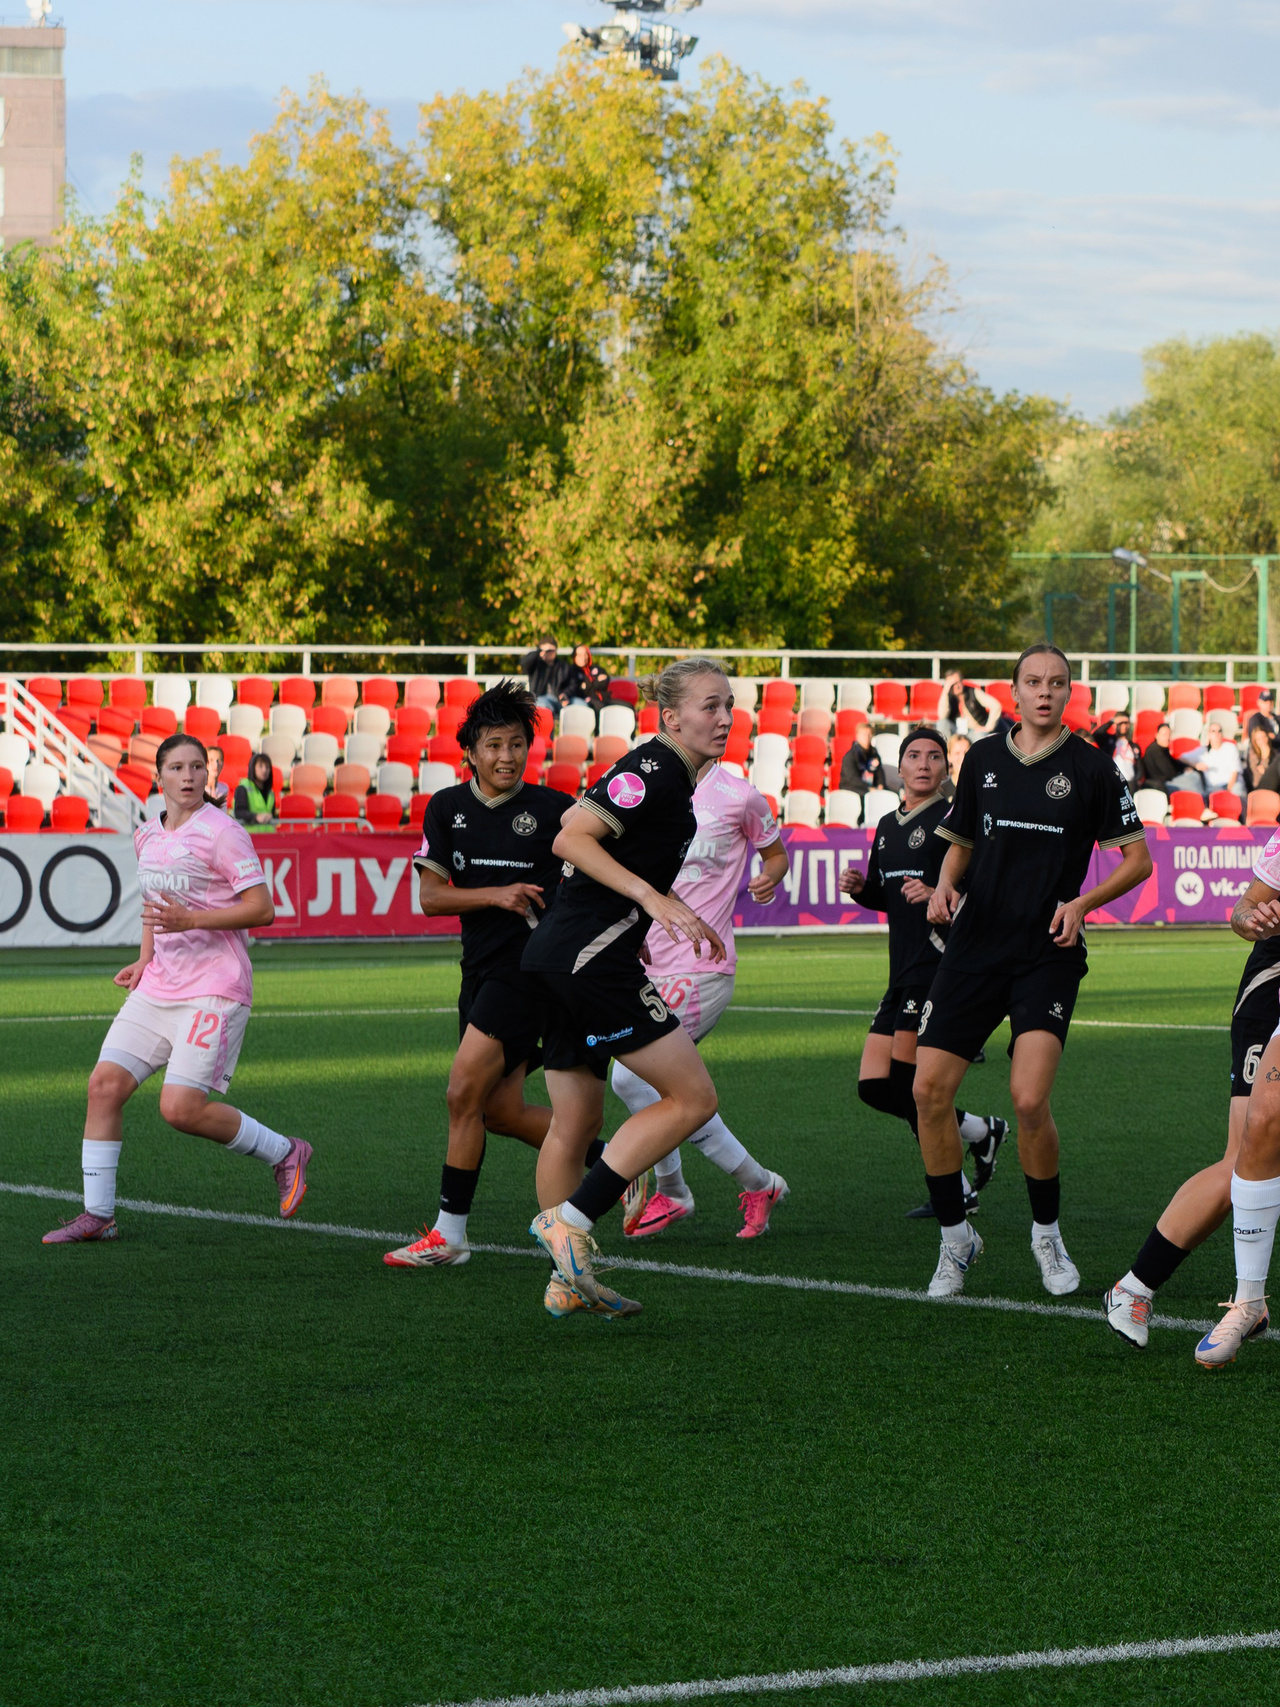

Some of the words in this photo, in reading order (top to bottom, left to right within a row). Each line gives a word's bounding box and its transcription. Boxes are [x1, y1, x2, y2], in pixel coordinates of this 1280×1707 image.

[138, 869, 190, 891] УКОЙЛ
[639, 982, 675, 1022] 5
[186, 1010, 220, 1050] 12
[1243, 1044, 1263, 1084] 6
